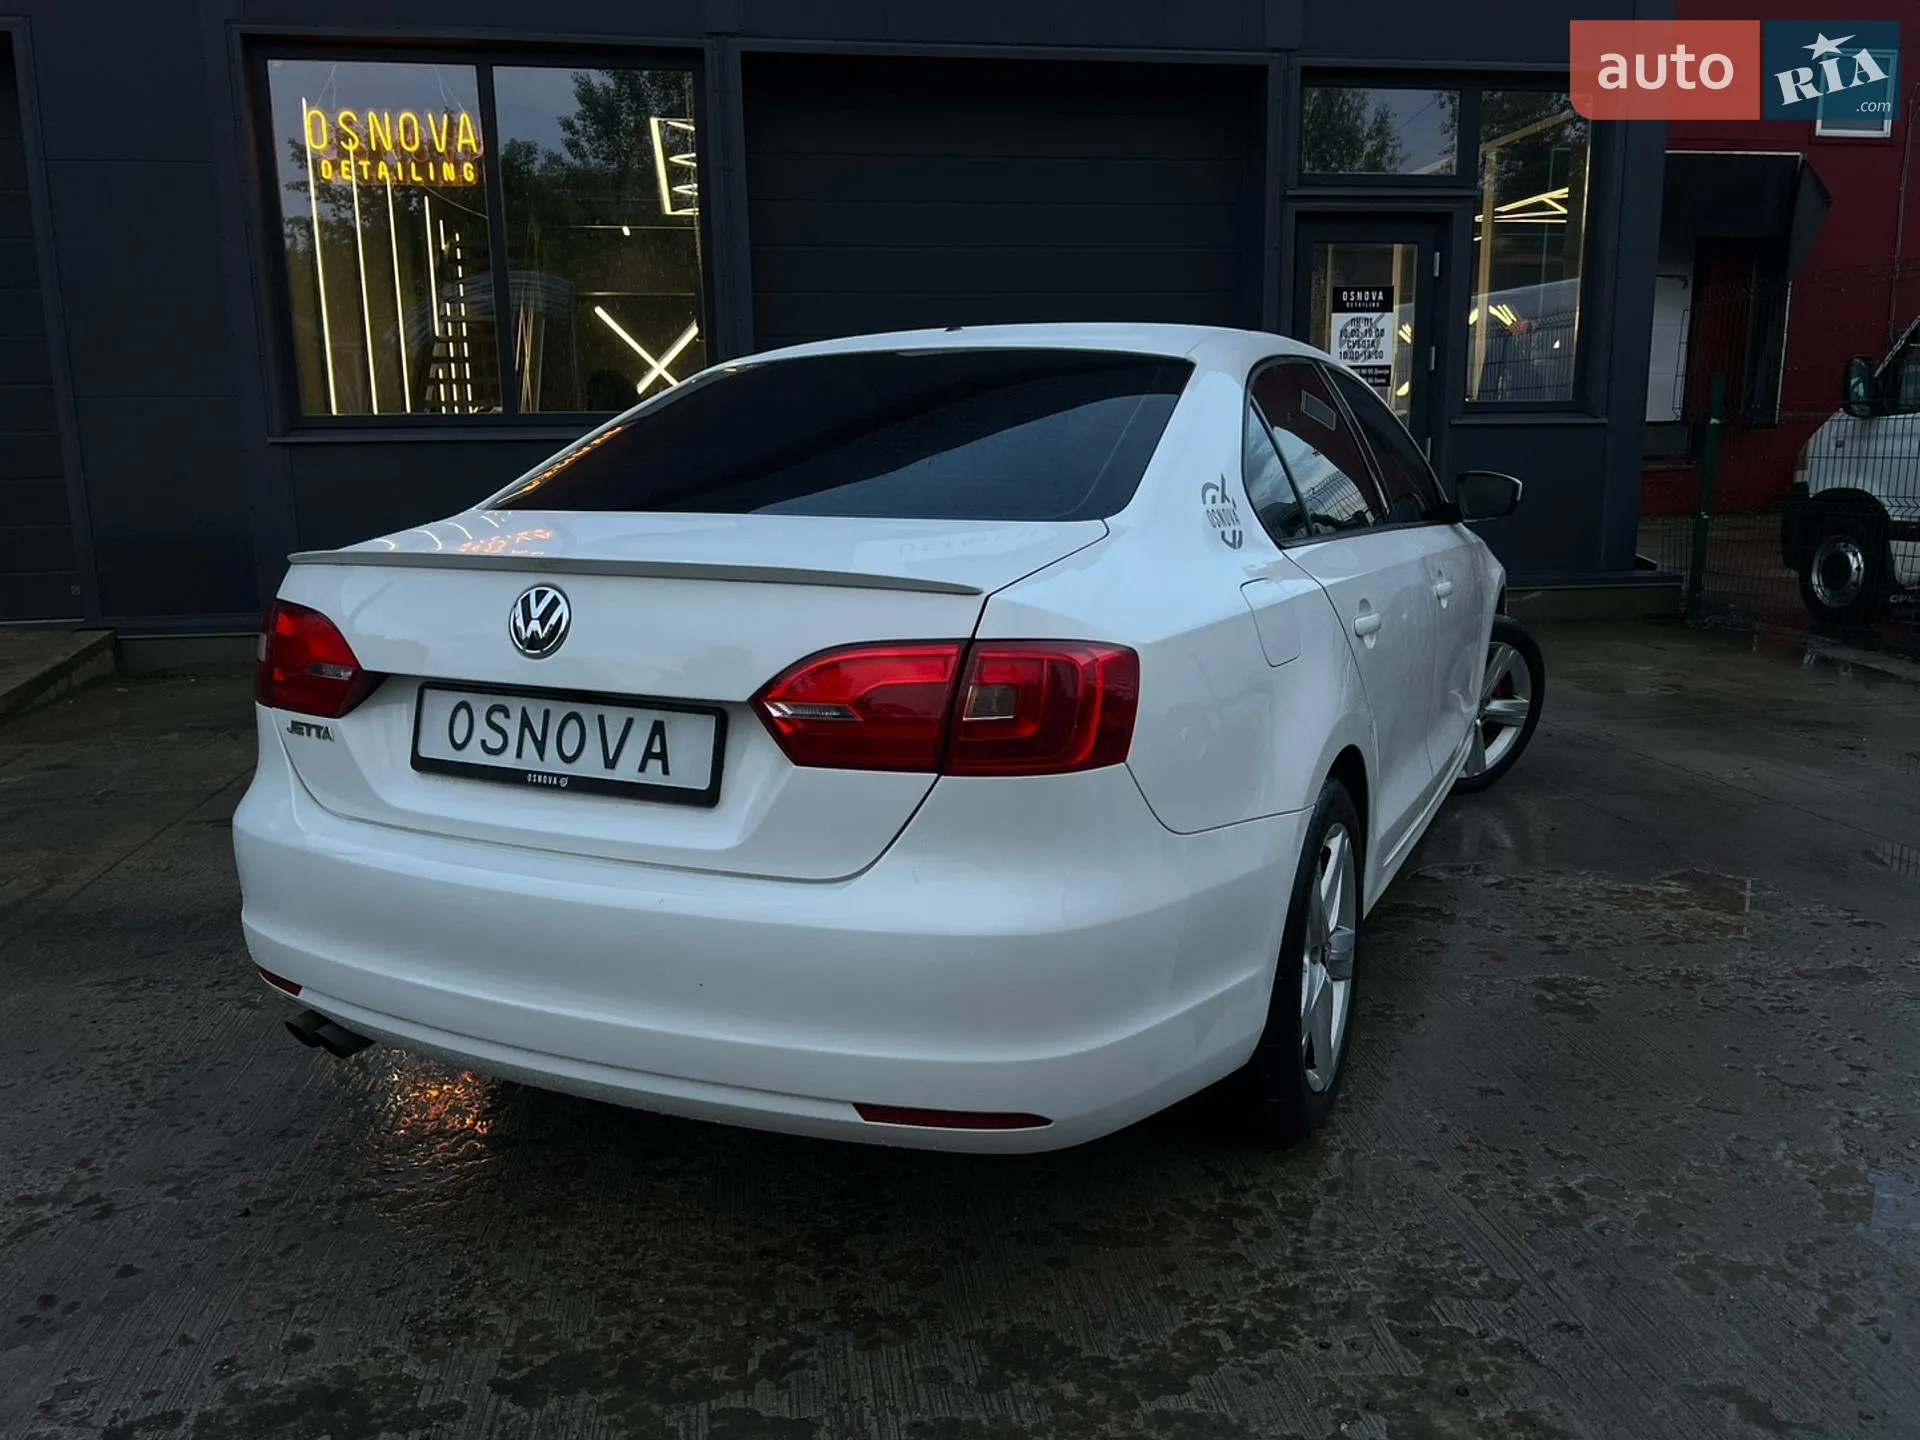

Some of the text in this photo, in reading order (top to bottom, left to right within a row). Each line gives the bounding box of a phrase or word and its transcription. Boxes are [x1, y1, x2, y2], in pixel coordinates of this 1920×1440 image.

[306, 109, 478, 153] OSNOVA
[320, 159, 476, 182] DETAILING
[1342, 290, 1384, 301] OSNOVA
[286, 719, 335, 742] JETTA
[448, 699, 671, 776] OSNOVA
[526, 773, 558, 785] OSNOVA
